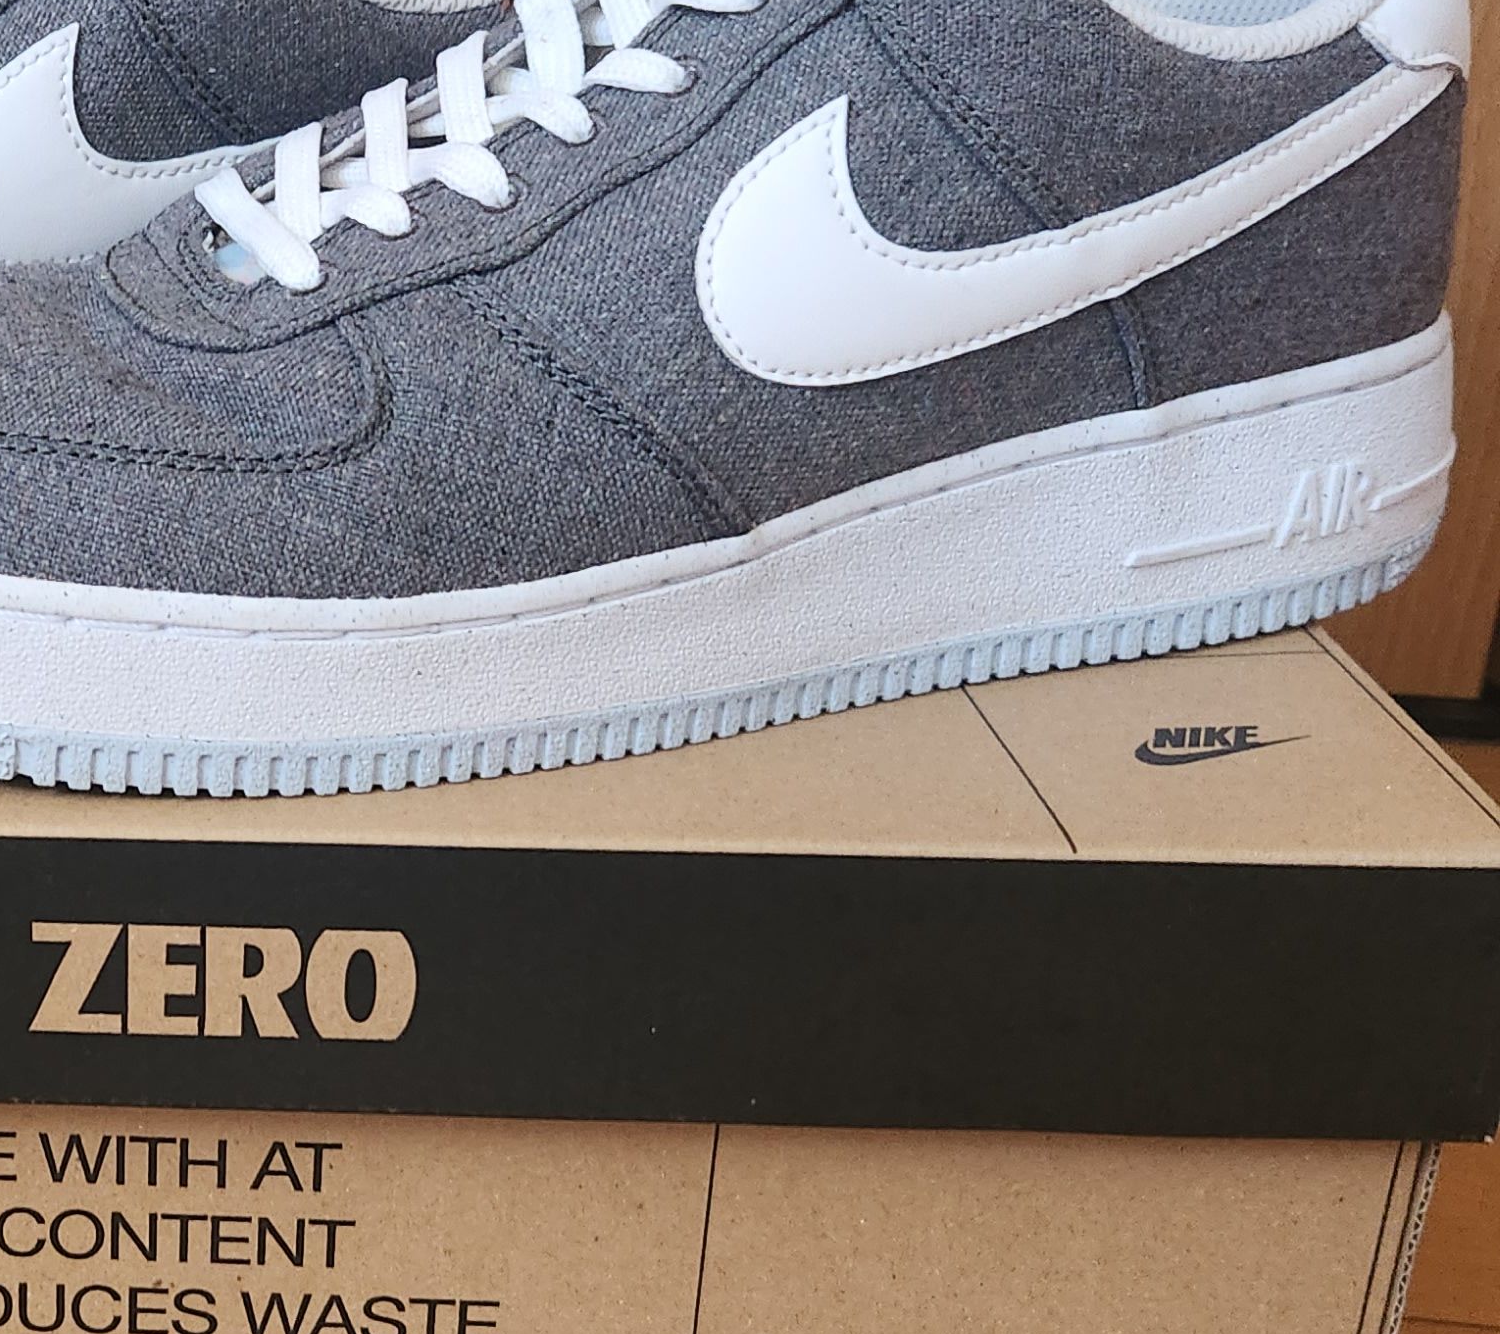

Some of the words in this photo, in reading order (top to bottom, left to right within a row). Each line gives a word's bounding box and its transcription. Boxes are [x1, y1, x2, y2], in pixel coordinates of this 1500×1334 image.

[1273, 461, 1370, 548] AIR
[1152, 725, 1259, 749] NIKE
[29, 921, 418, 1041] ZERO
[39, 1131, 229, 1191] WITH
[250, 1140, 343, 1193] AT
